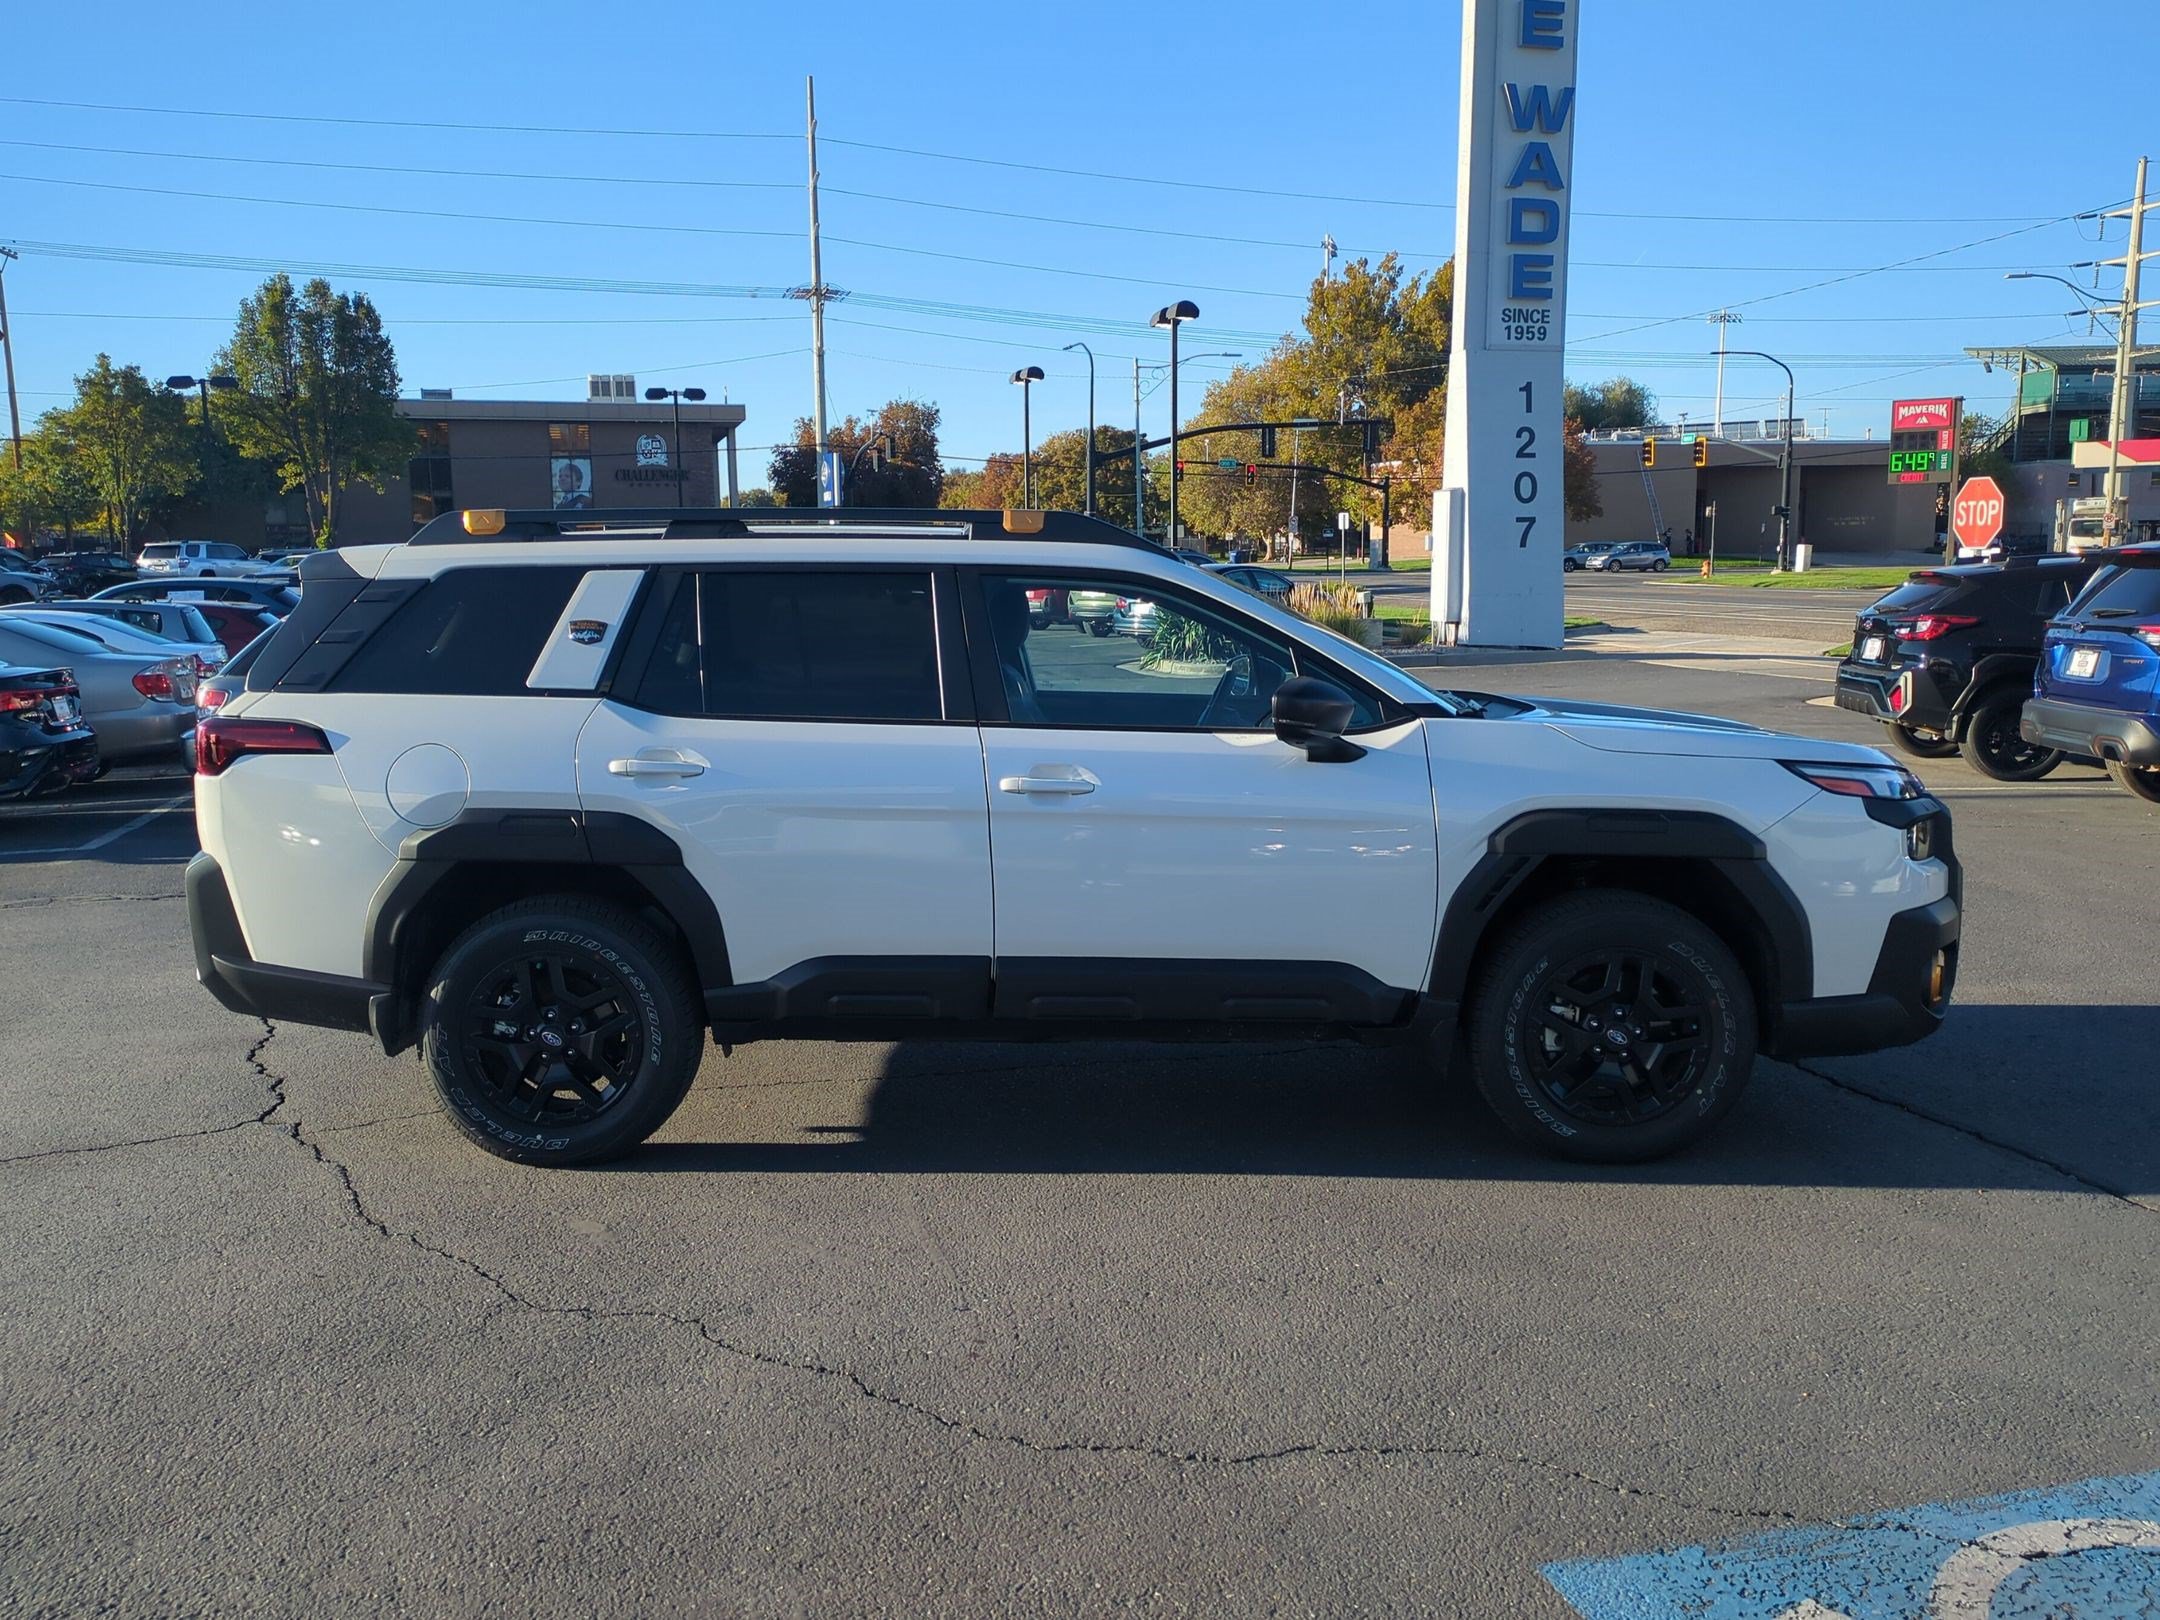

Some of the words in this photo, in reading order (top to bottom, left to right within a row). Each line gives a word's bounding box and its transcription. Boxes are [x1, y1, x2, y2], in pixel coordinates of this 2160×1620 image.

[1503, 82, 1576, 300] WADE
[1501, 308, 1551, 324] SINCE
[1504, 325, 1548, 341] 1959
[1898, 404, 1949, 420] MAVERIK
[1513, 381, 1538, 548] 1207
[1957, 500, 2000, 527] STOP
[523, 929, 663, 1066] BRIDGESTONE
[1668, 941, 1737, 1057] DUELER
[1504, 956, 1578, 1138] BRIDGESTONE
[451, 1086, 571, 1151] DUELER
